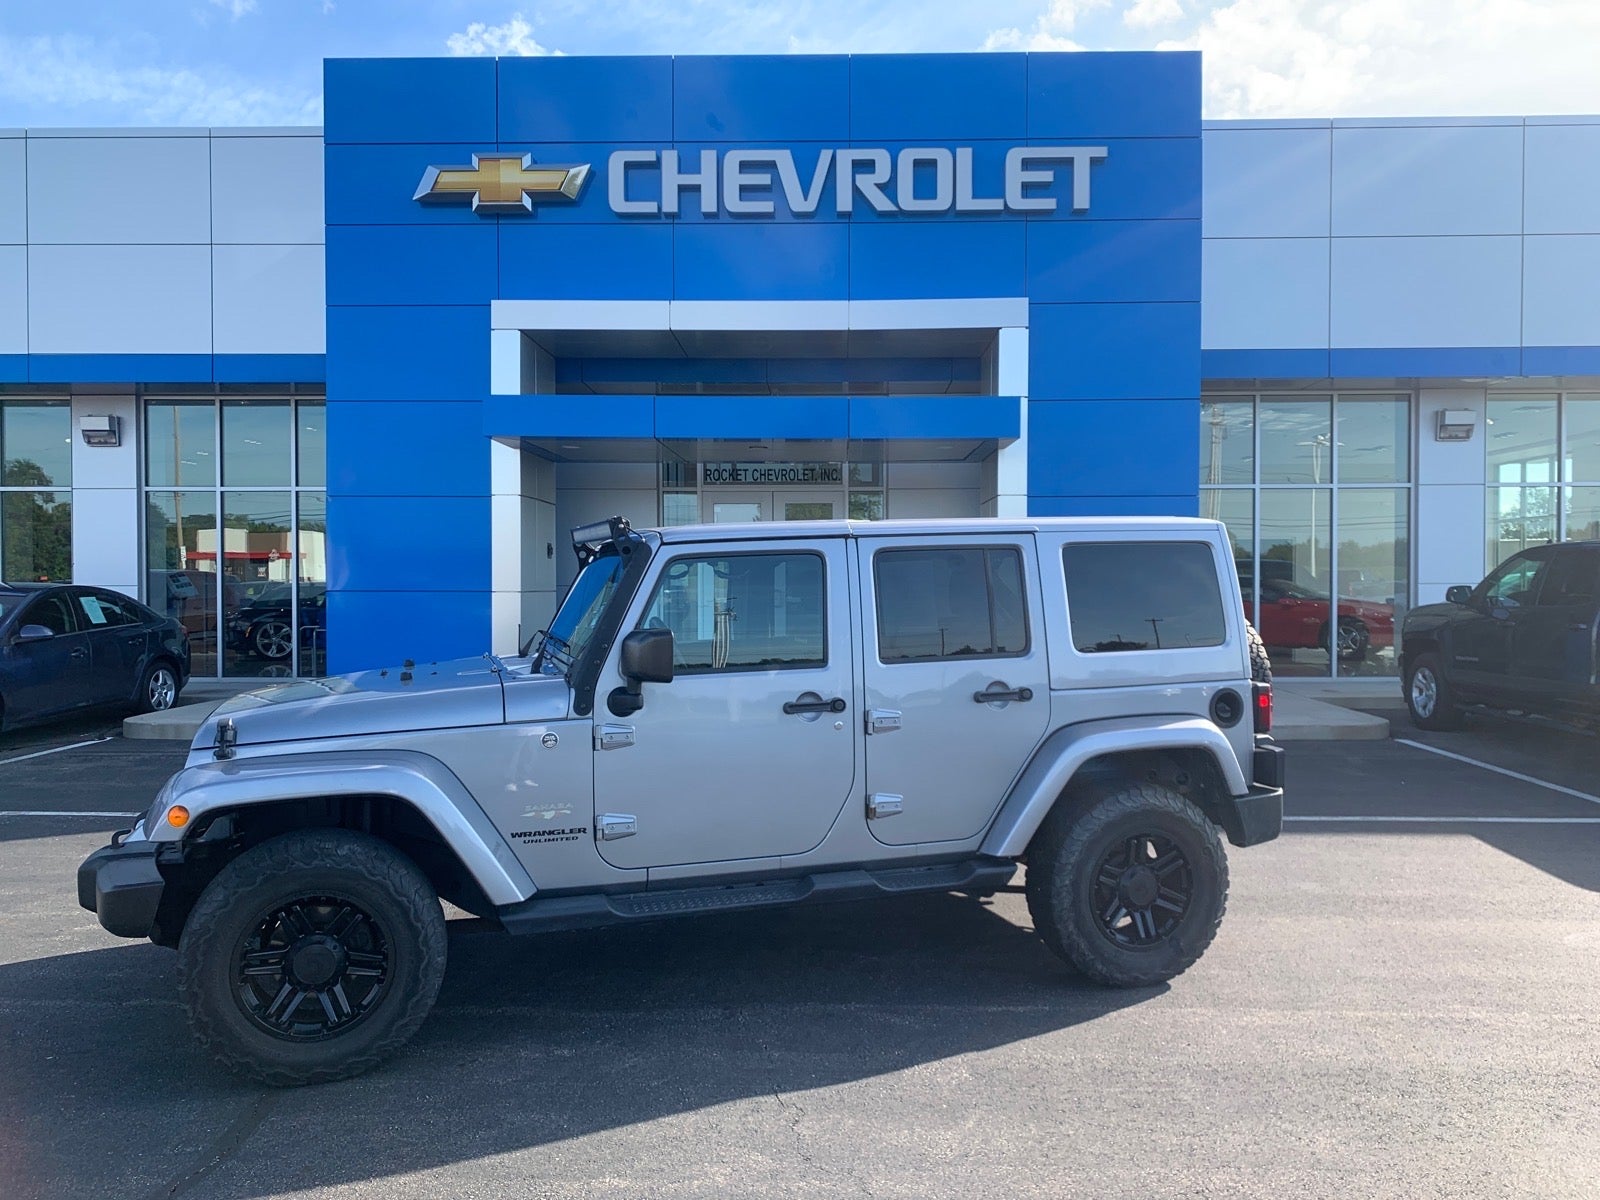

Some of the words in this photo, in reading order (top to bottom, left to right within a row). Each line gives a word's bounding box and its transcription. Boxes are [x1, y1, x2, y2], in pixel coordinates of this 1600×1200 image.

[608, 147, 1108, 215] CHEVROLET
[705, 468, 749, 481] ROCKET
[820, 468, 841, 482] INC.
[511, 827, 587, 838] WRANGLER
[523, 836, 579, 844] UNLIMITED
